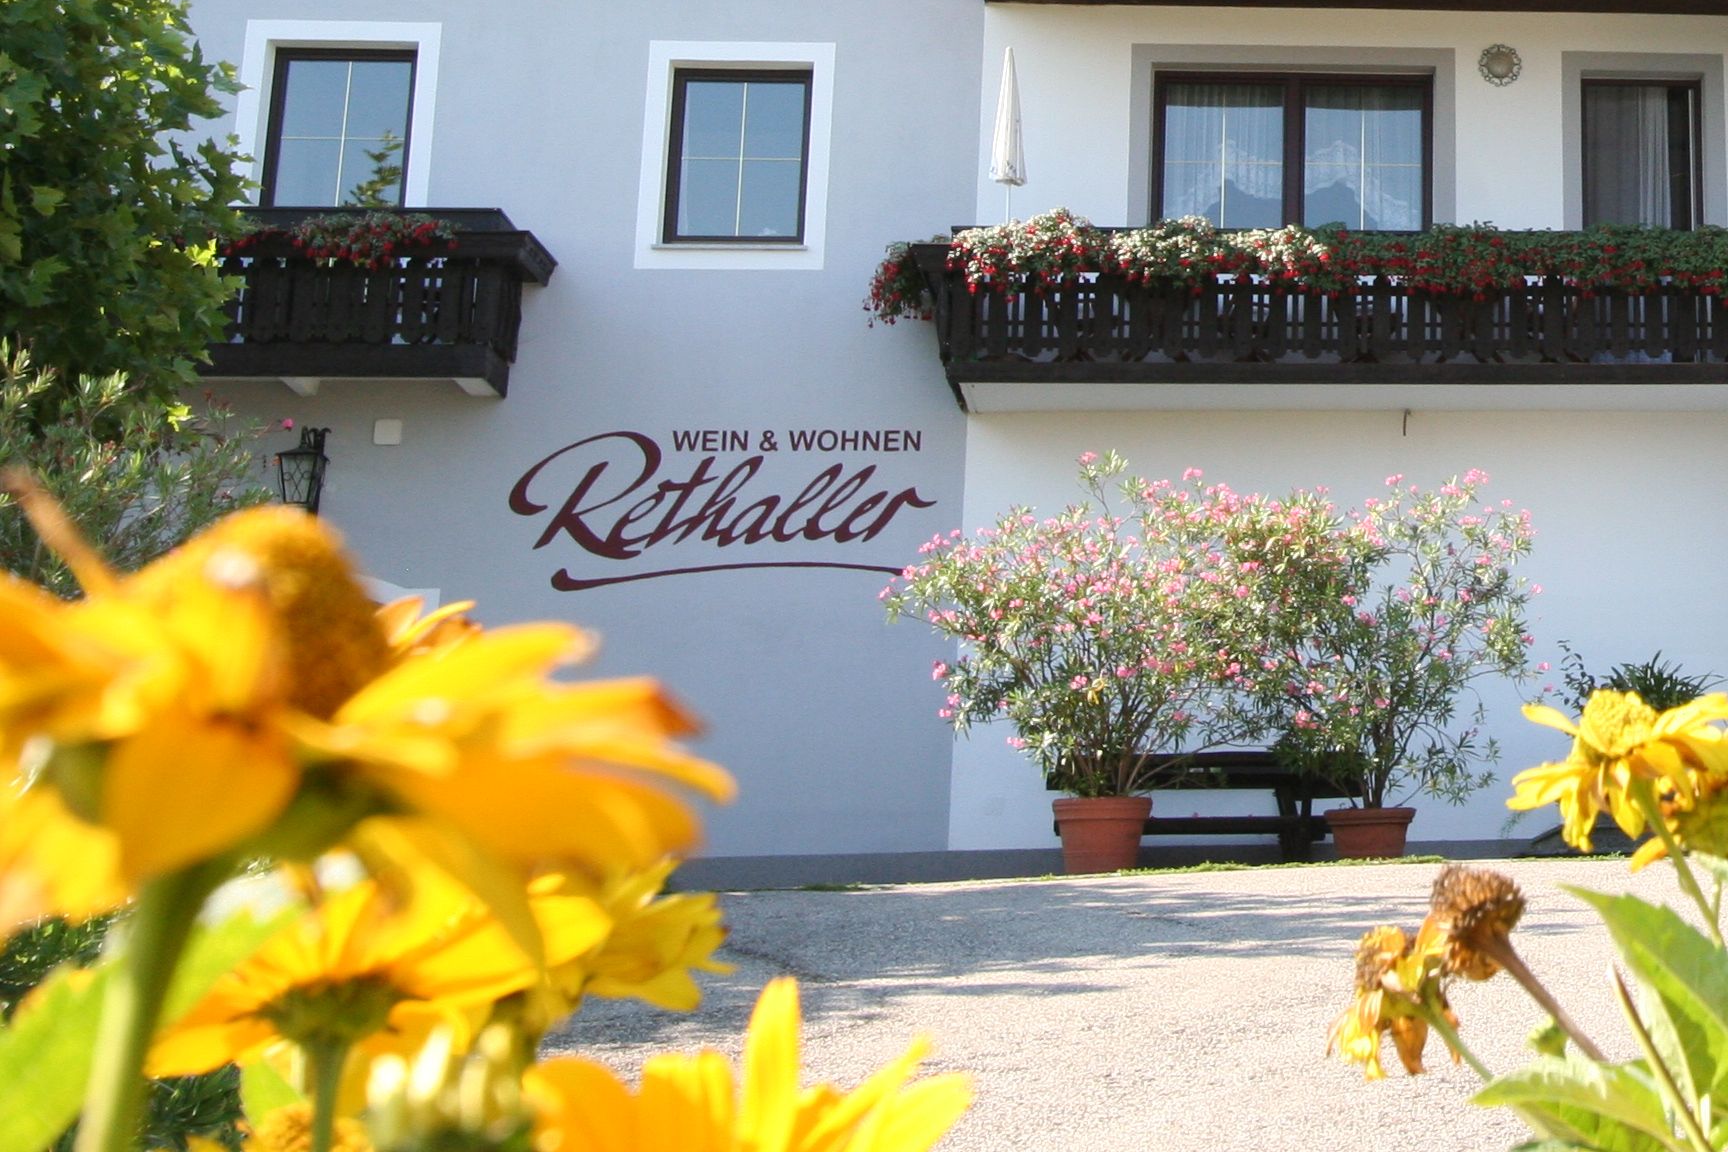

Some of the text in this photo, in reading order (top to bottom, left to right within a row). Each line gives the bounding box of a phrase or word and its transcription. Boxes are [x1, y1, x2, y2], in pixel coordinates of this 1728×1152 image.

[672, 429, 922, 452] WEIN & WOHNEN
[508, 430, 938, 560] Rethaller
